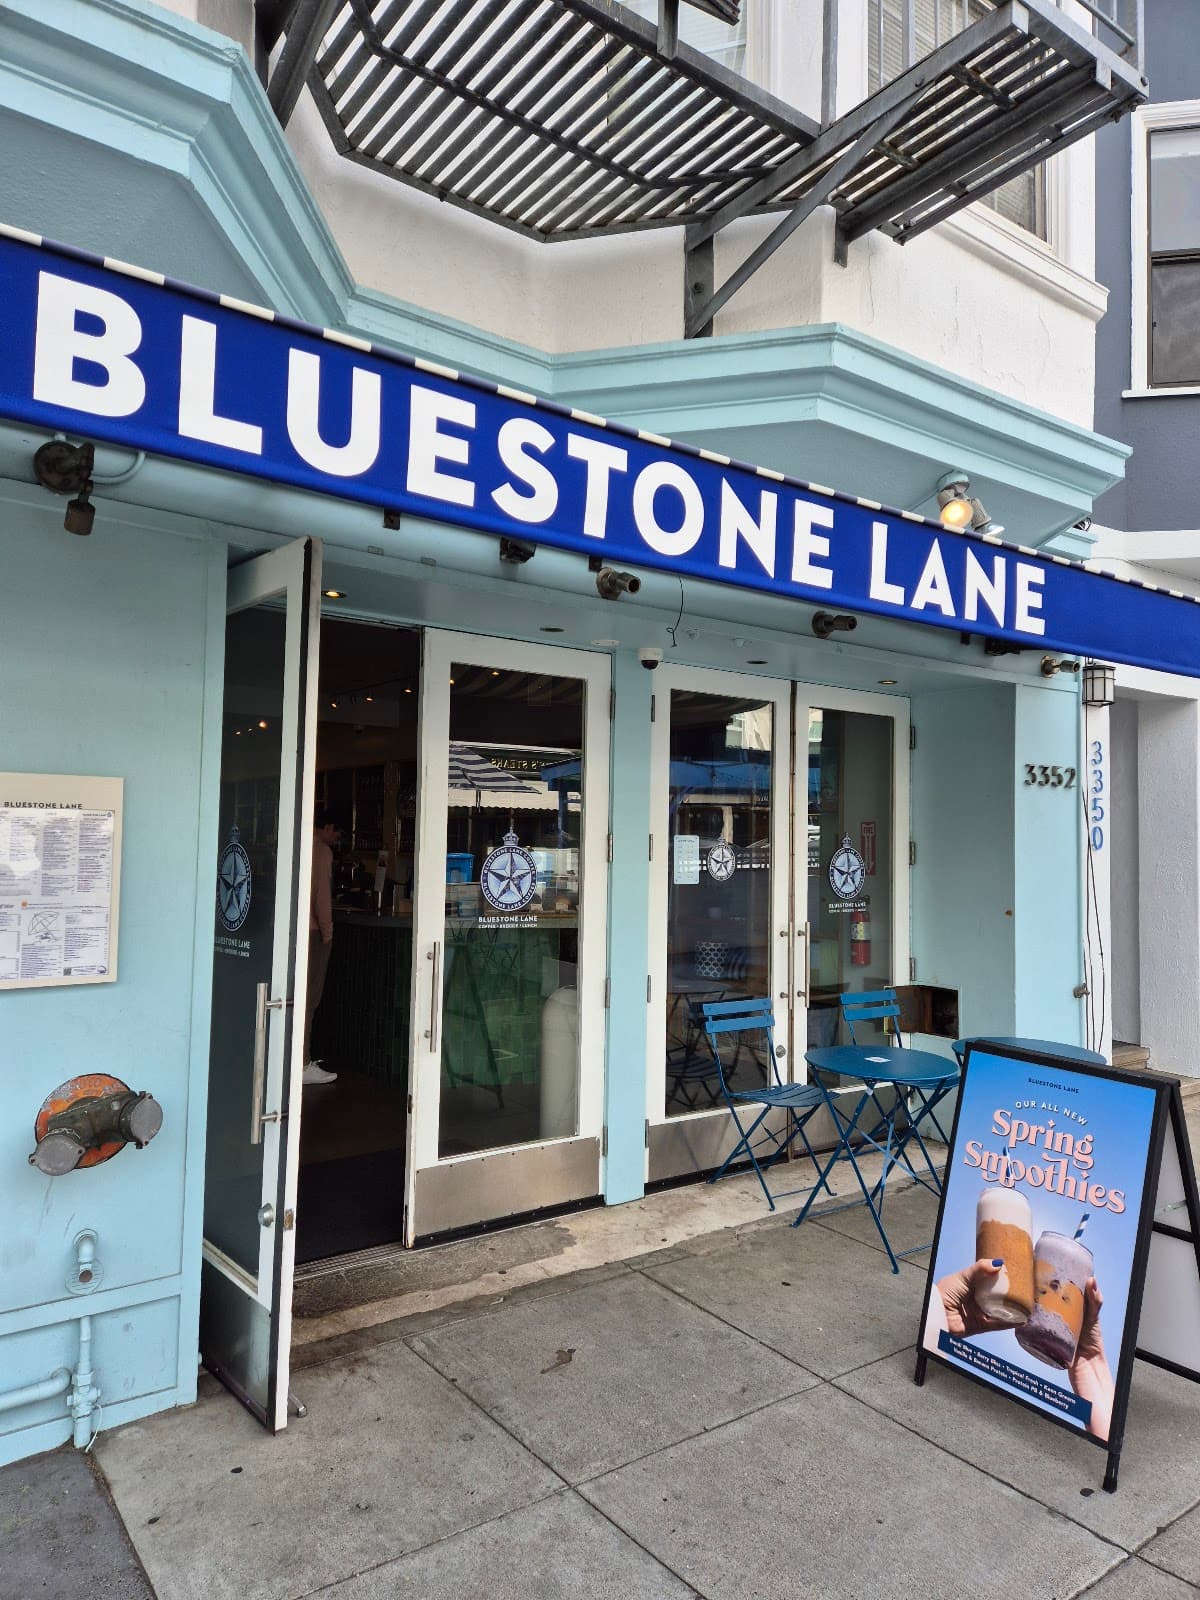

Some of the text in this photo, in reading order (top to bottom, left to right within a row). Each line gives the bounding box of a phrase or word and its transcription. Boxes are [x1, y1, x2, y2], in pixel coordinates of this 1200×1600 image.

[33, 270, 1046, 636] BLUESTONE LANE
[1023, 763, 1077, 789] 3352
[4, 801, 57, 809] BLUESTONE
[1090, 740, 1105, 851] 3350
[478, 915, 519, 923] BLUESTONE
[1028, 1077, 1080, 1094] BLUESTONE LANE
[1015, 1100, 1088, 1126] OUR ALL NEW
[991, 1109, 1095, 1170] Spring
[963, 1140, 1127, 1215] Smoothies
